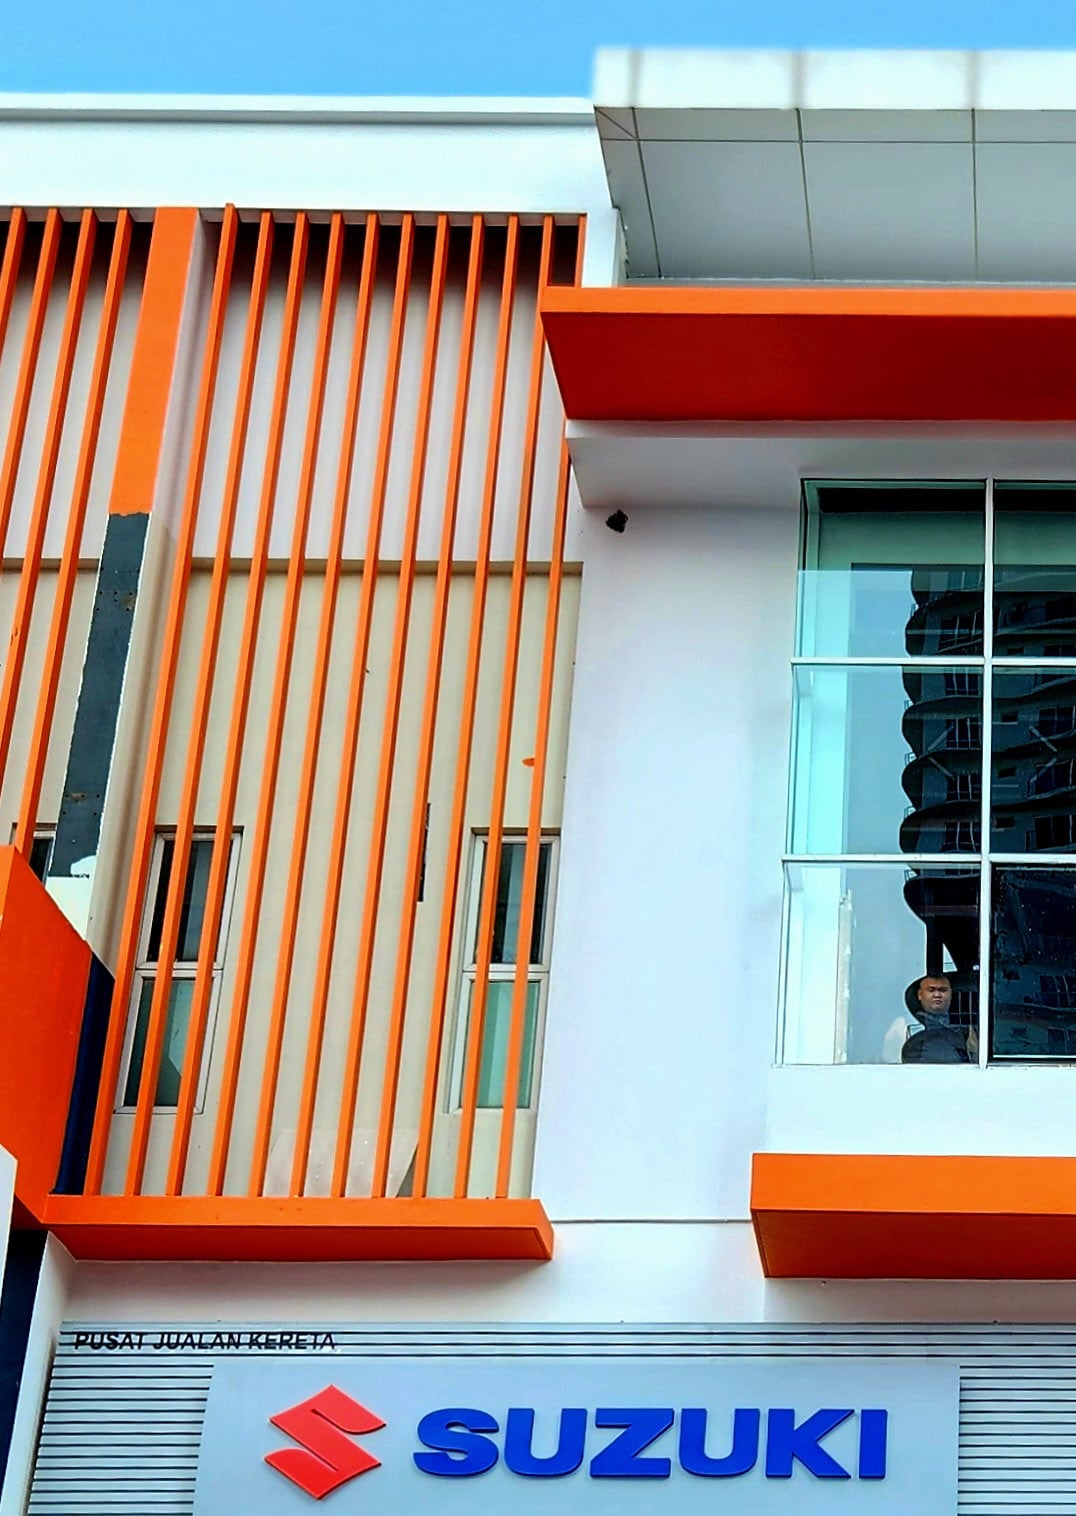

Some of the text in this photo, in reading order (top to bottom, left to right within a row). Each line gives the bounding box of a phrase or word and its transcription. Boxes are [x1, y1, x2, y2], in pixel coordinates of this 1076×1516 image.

[74, 1331, 336, 1350] PUSAT JUALAN KERETA
[412, 1407, 888, 1481] SUZUKI
